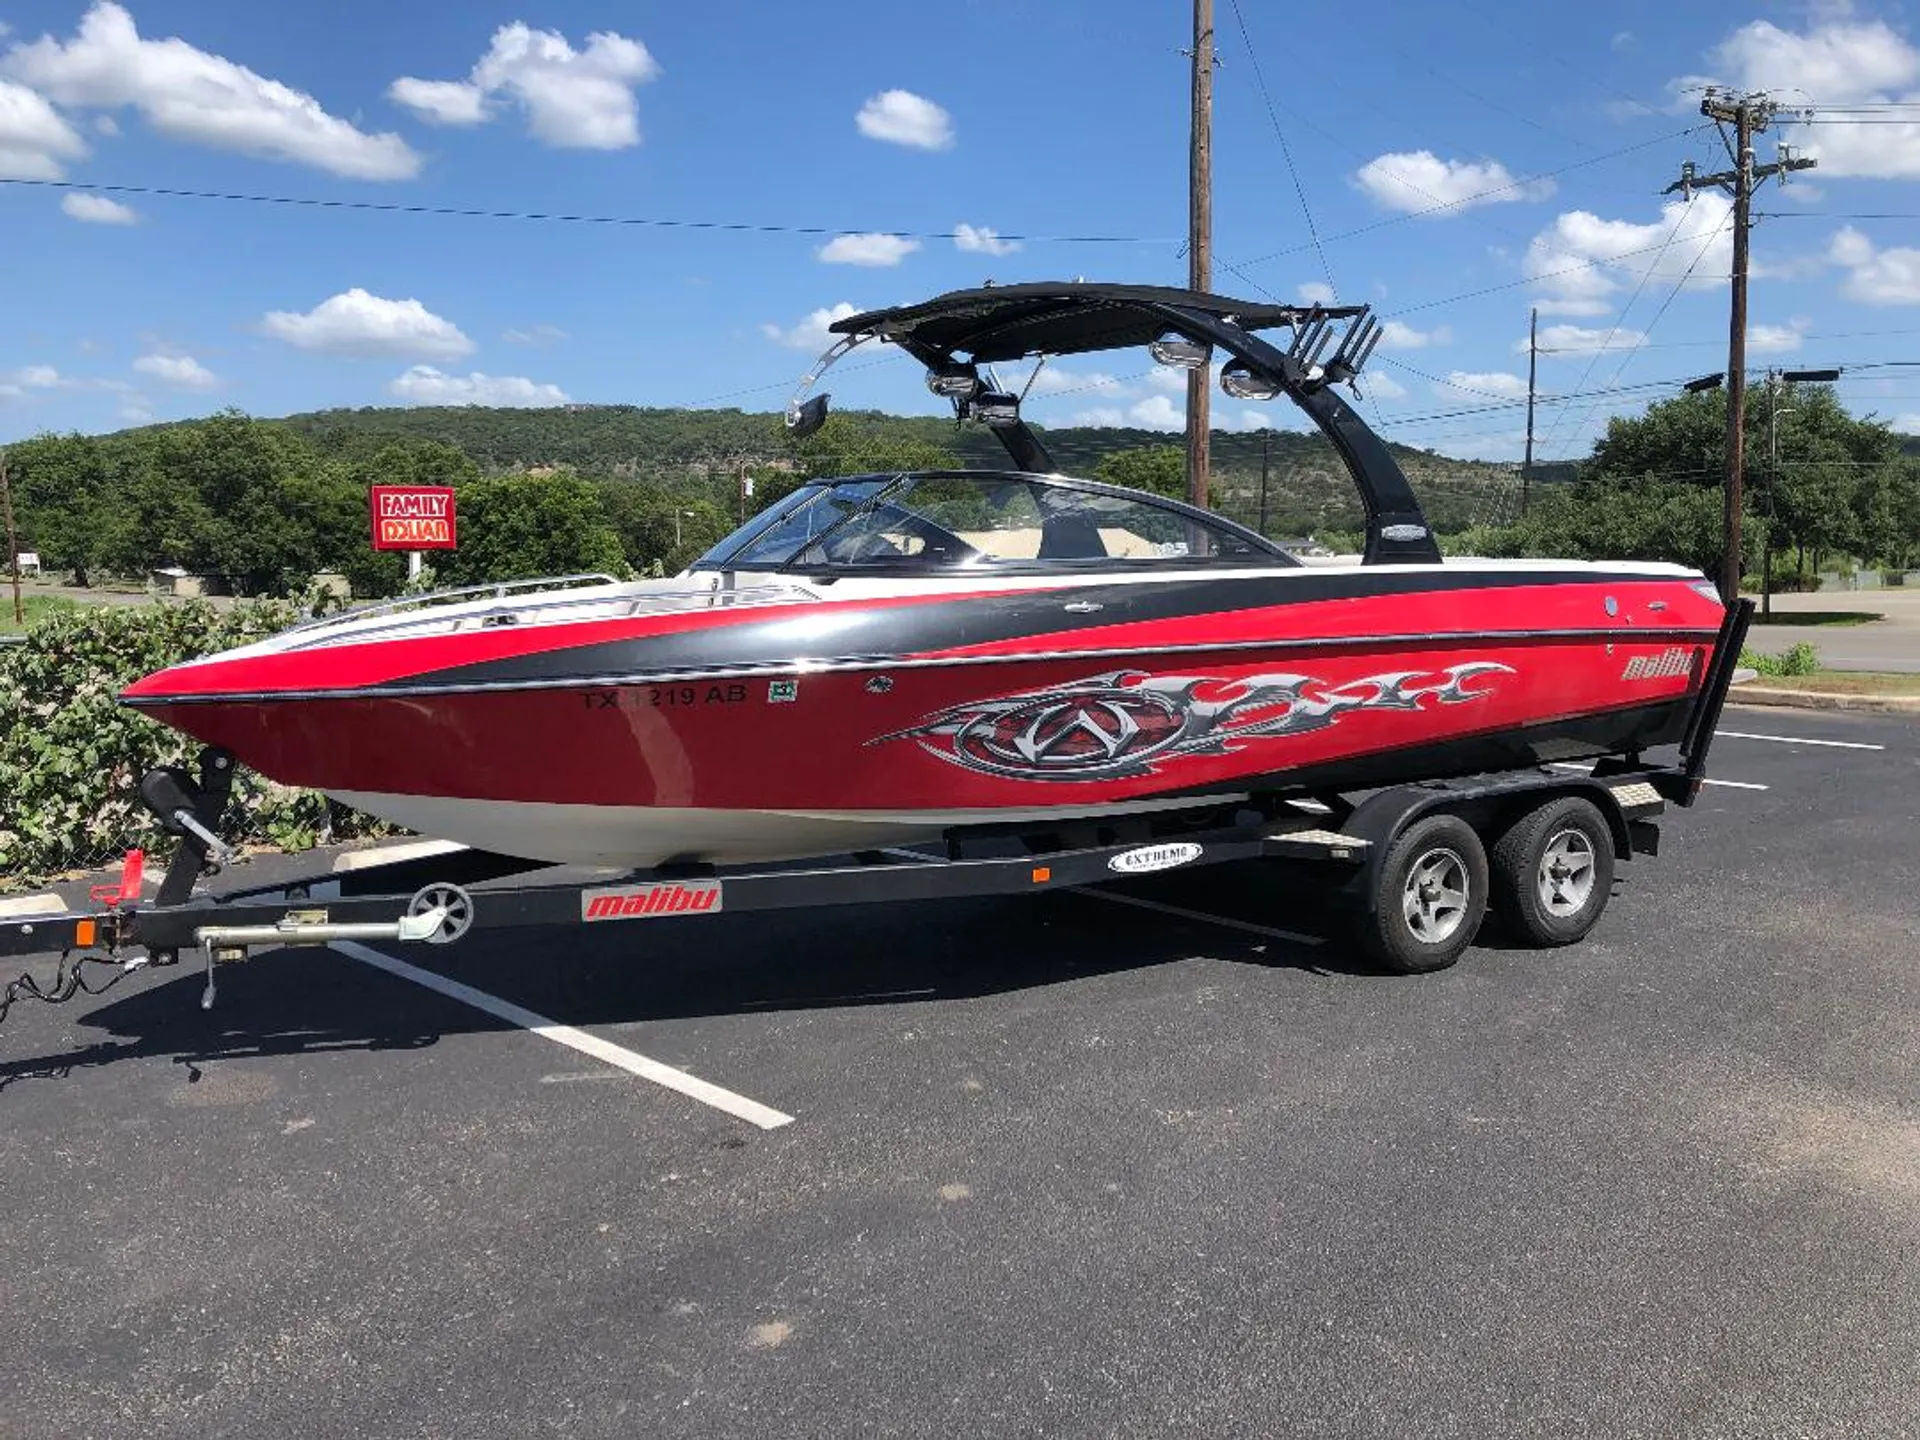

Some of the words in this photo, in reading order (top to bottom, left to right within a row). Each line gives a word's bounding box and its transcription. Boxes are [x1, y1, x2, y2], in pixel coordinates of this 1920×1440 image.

[380, 494, 449, 516] FAMILY
[381, 519, 450, 541] DOLLAR
[579, 690, 619, 709] TX
[704, 684, 747, 704] AB
[586, 885, 718, 917] malibu
